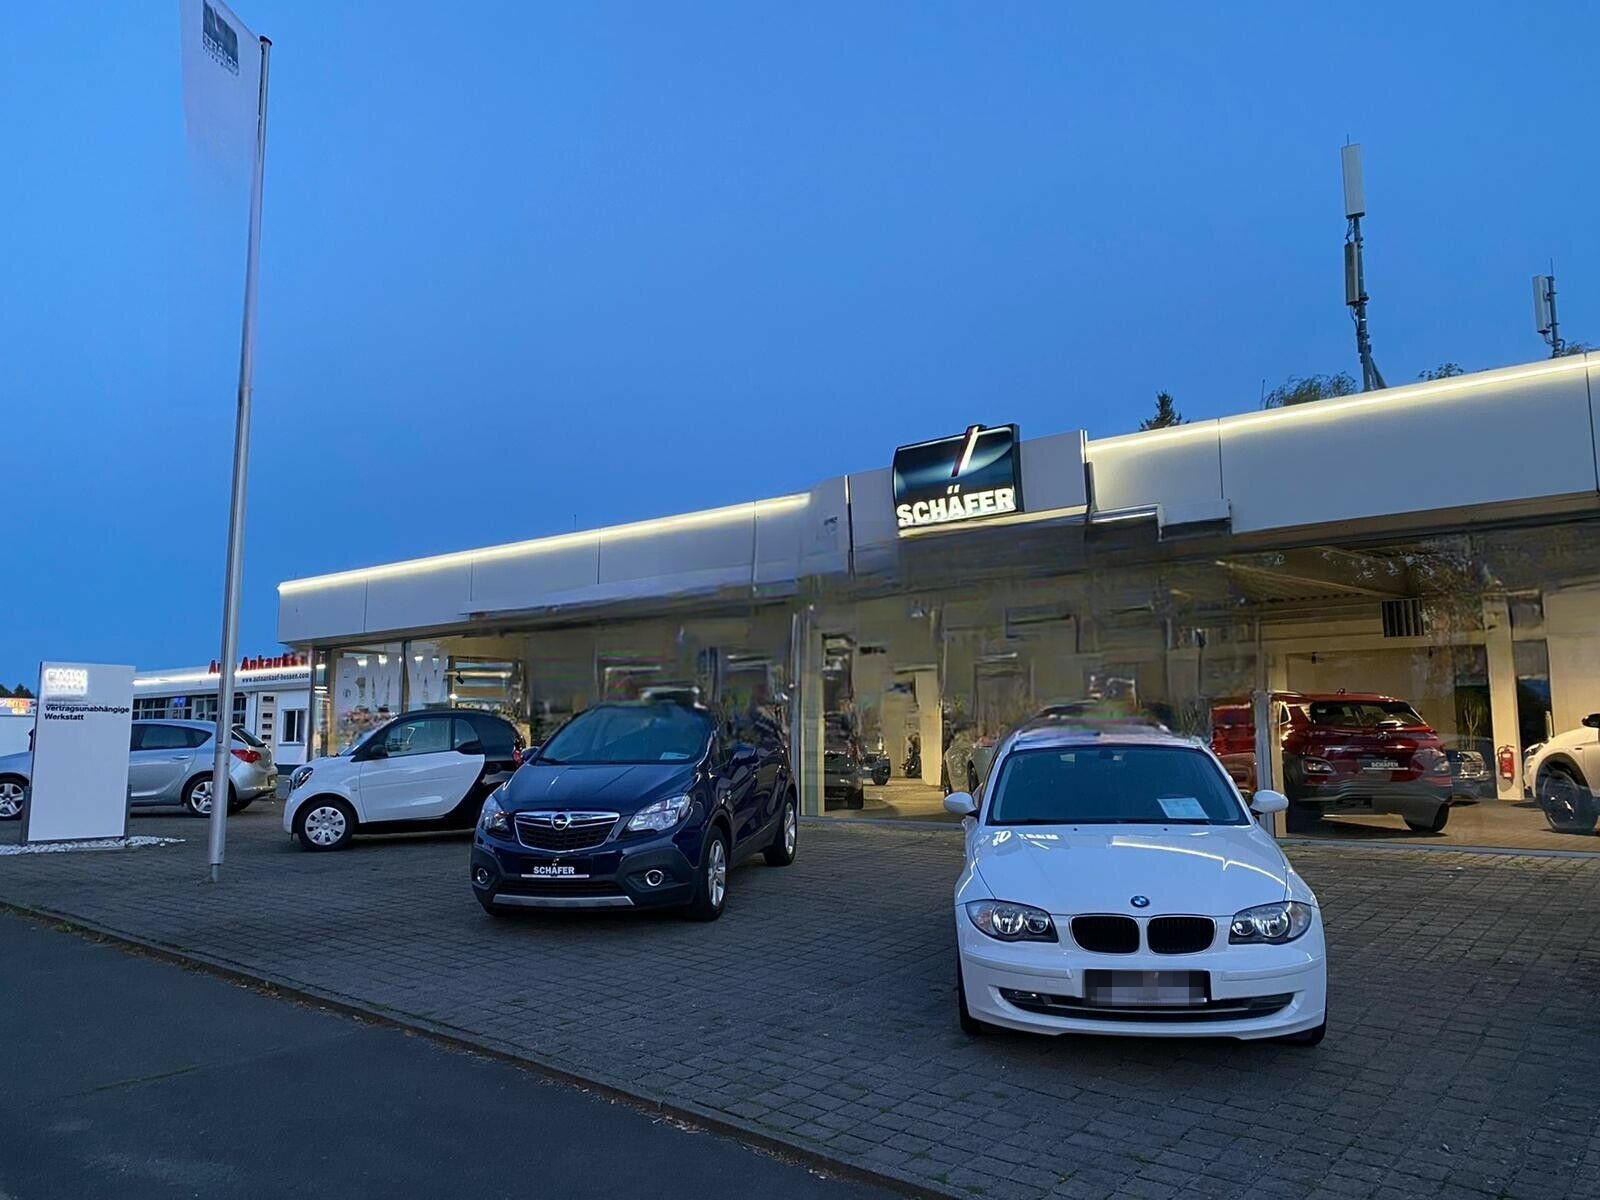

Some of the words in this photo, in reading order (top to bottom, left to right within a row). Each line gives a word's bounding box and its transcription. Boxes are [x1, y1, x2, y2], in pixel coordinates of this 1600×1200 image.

[896, 484, 1016, 527] SCHÄFER
[45, 704, 129, 713] Vertragsunabhängige
[533, 863, 575, 875] SCHÄFER
